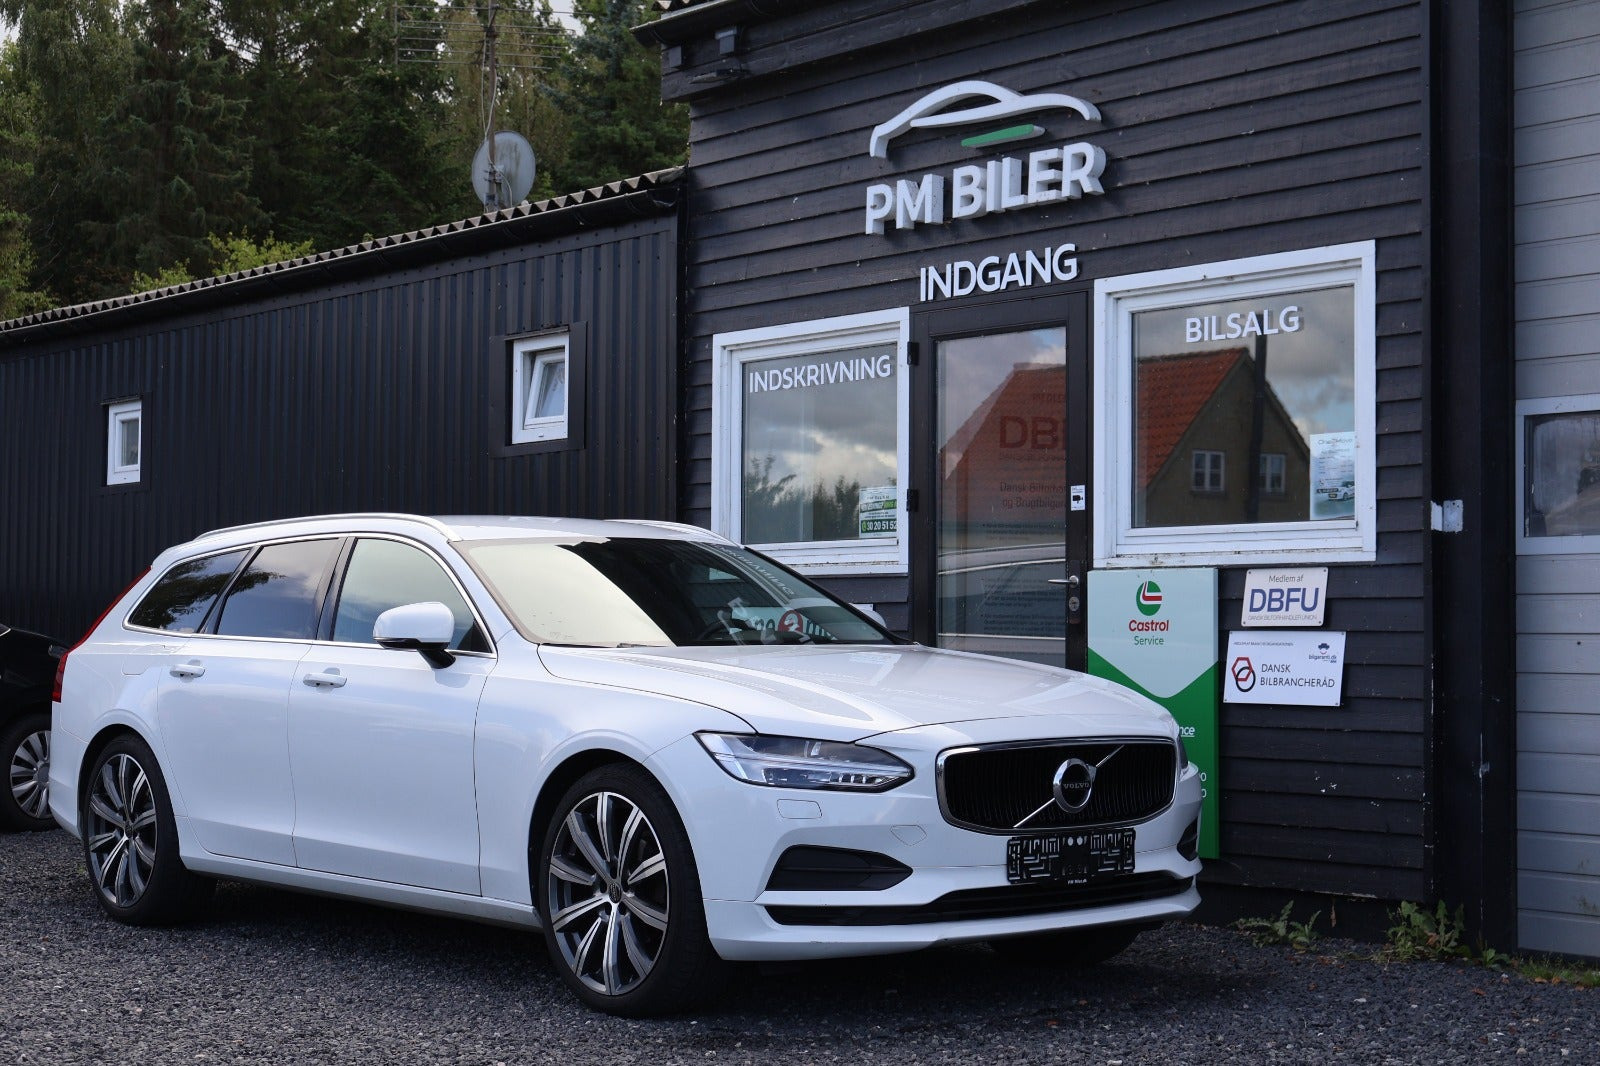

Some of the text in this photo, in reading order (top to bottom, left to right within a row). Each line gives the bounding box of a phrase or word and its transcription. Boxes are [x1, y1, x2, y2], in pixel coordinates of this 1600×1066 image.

[865, 142, 1106, 235] PM BILER
[920, 243, 1078, 302] INDGANG
[1185, 305, 1301, 343] BILSALG
[749, 354, 892, 393] INDSKRIVNING
[1000, 416, 1066, 449] DB
[882, 521, 889, 530] 51
[1268, 574, 1304, 583] Medlem af
[1249, 588, 1320, 612] DBFU
[1128, 619, 1170, 632] Castrol
[1134, 635, 1165, 646] Service
[1261, 664, 1291, 673] DANSK
[1260, 676, 1335, 688] BILBRANCHERÅD
[1180, 726, 1196, 736] nce
